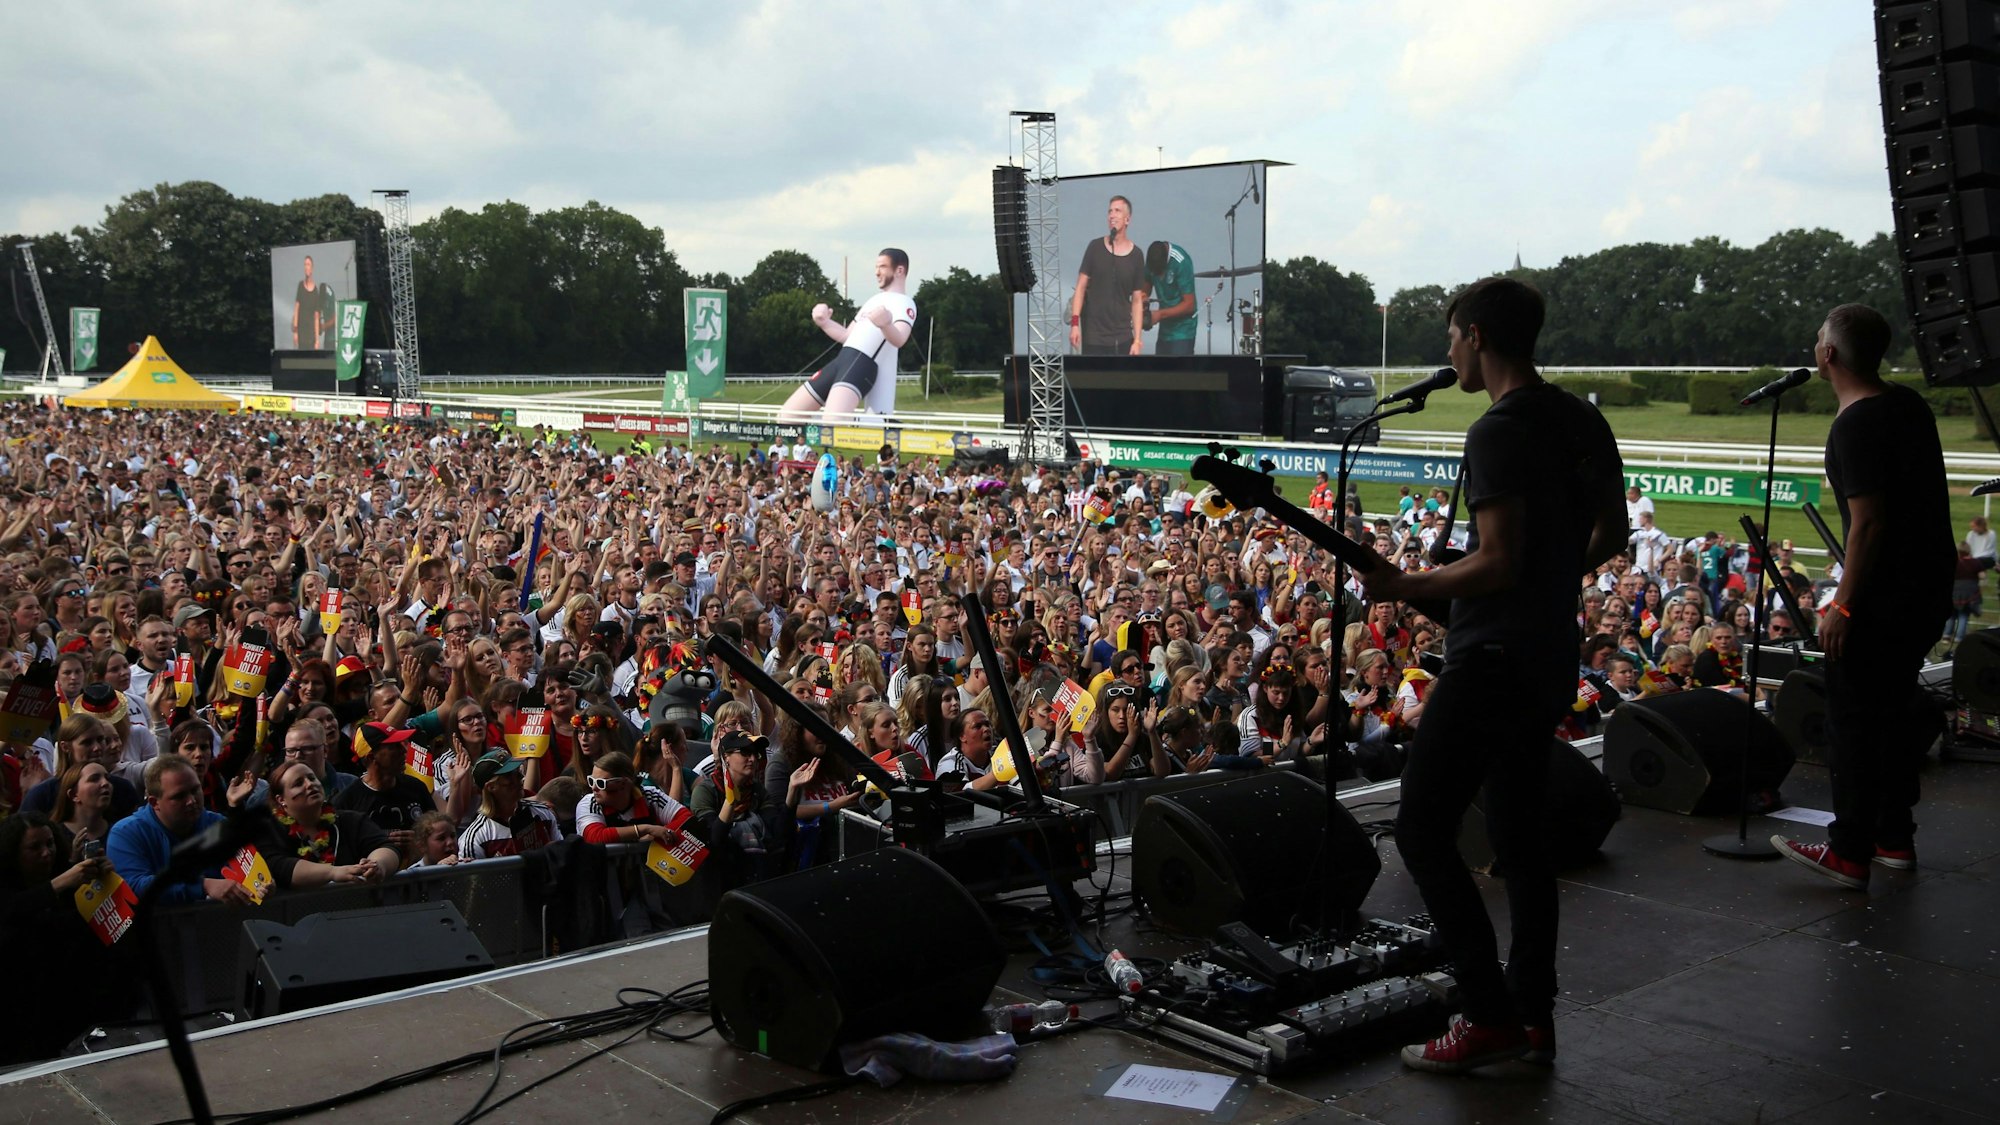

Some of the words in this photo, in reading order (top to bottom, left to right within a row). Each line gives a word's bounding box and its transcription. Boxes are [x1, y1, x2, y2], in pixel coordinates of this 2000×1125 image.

[743, 424, 762, 435] wächst
[763, 426, 774, 436] die
[1109, 446, 1140, 461] DEVK
[1760, 480, 1793, 491] WETT
[1770, 490, 1798, 502] STAR
[242, 641, 266, 654] SCHWATZ
[244, 651, 263, 664] RUT
[238, 661, 262, 676] JOLD!
[1059, 685, 1074, 706] RUT
[521, 706, 546, 715] SCHWATZ
[526, 714, 545, 726] RUT
[521, 725, 545, 737] JOLD!
[411, 740, 429, 756] SCHWATZ
[414, 750, 428, 765] RUT
[681, 829, 706, 850] SCHWATZ
[678, 839, 701, 857] RUT
[667, 846, 695, 867] JOLD!
[103, 909, 123, 935] RUT
[111, 915, 133, 943] SCHWATZ
